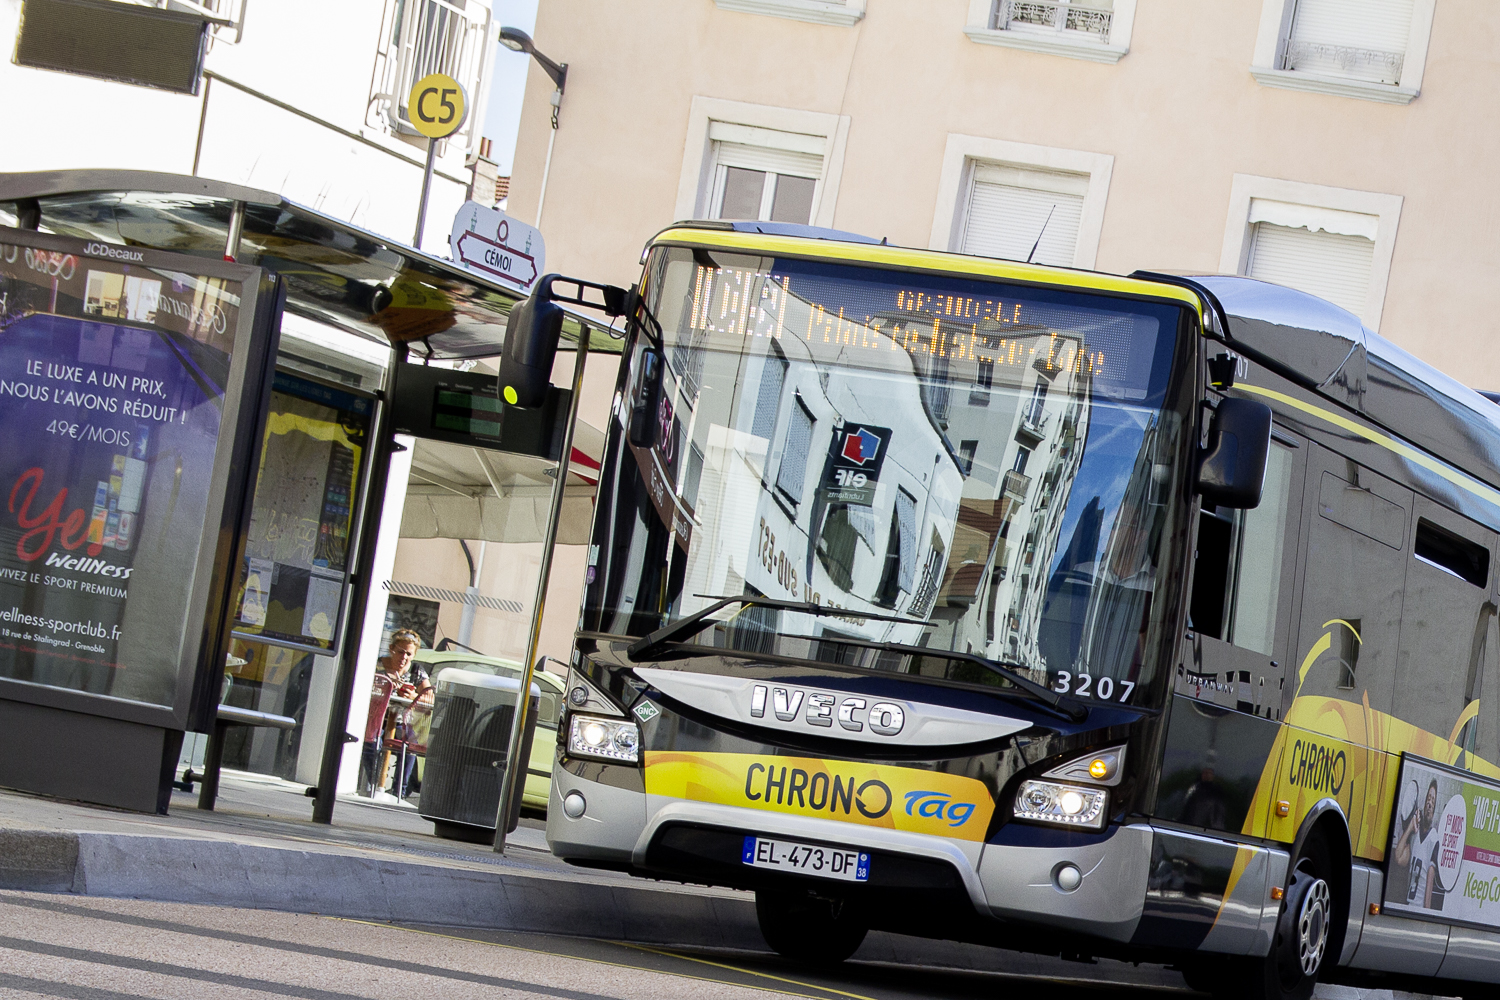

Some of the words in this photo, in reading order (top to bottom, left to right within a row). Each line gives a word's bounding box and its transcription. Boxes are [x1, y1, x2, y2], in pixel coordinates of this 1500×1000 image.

[416, 87, 458, 125] C5
[84, 242, 144, 262] JCDecaux
[484, 248, 513, 273] CÉMOI
[27, 359, 43, 376] LE
[48, 363, 84, 383] LUXE
[87, 371, 98, 385] A
[102, 373, 127, 391] UN
[131, 376, 167, 399] PRIX,
[1, 380, 49, 401] NOUS
[54, 389, 118, 413] L'AVONS
[123, 398, 177, 423] RÉDUIT
[181, 410, 187, 425] !
[46, 419, 131, 447] 49€/MOIS
[30, 573, 41, 584] LE
[44, 575, 78, 591] SPORT
[81, 581, 128, 599] PREMIUM
[11, 631, 22, 639] rue
[23, 631, 32, 641] de
[34, 633, 71, 648] Stalingrad
[75, 641, 106, 654] Grenoble
[1054, 670, 1135, 703] 3207
[1187, 674, 1234, 695] URBANWAY
[637, 706, 655, 716] GNC
[750, 685, 906, 737] IVECO
[1289, 738, 1347, 796] CHRONO
[745, 762, 893, 819] CHRONO
[904, 790, 977, 827] Tag
[756, 841, 857, 875] EL-473-DF
[857, 867, 867, 878] 38
